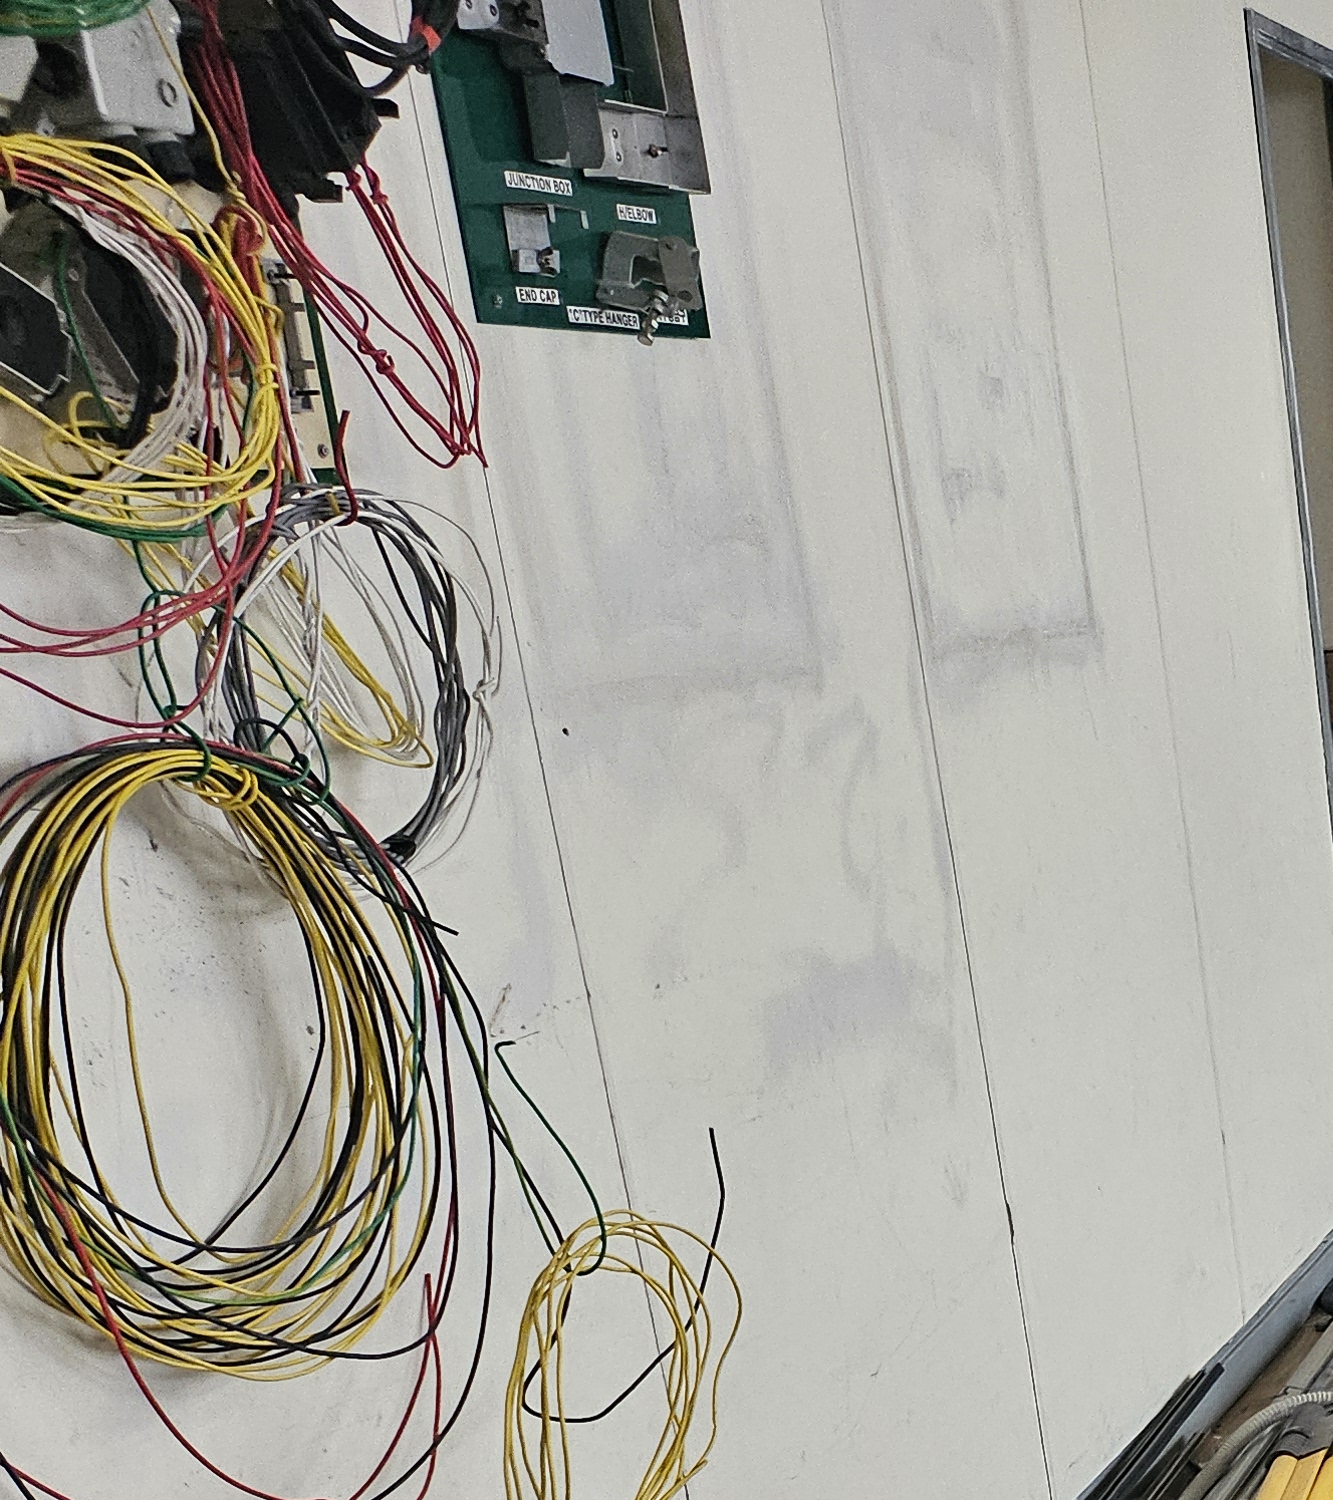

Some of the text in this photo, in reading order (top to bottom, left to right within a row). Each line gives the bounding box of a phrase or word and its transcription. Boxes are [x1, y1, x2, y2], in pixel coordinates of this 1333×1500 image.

[507, 172, 572, 195] JUNCTION BOX
[618, 205, 655, 223] H/ELBOW
[518, 288, 557, 303] END CAP
[605, 311, 639, 328] HANGER
